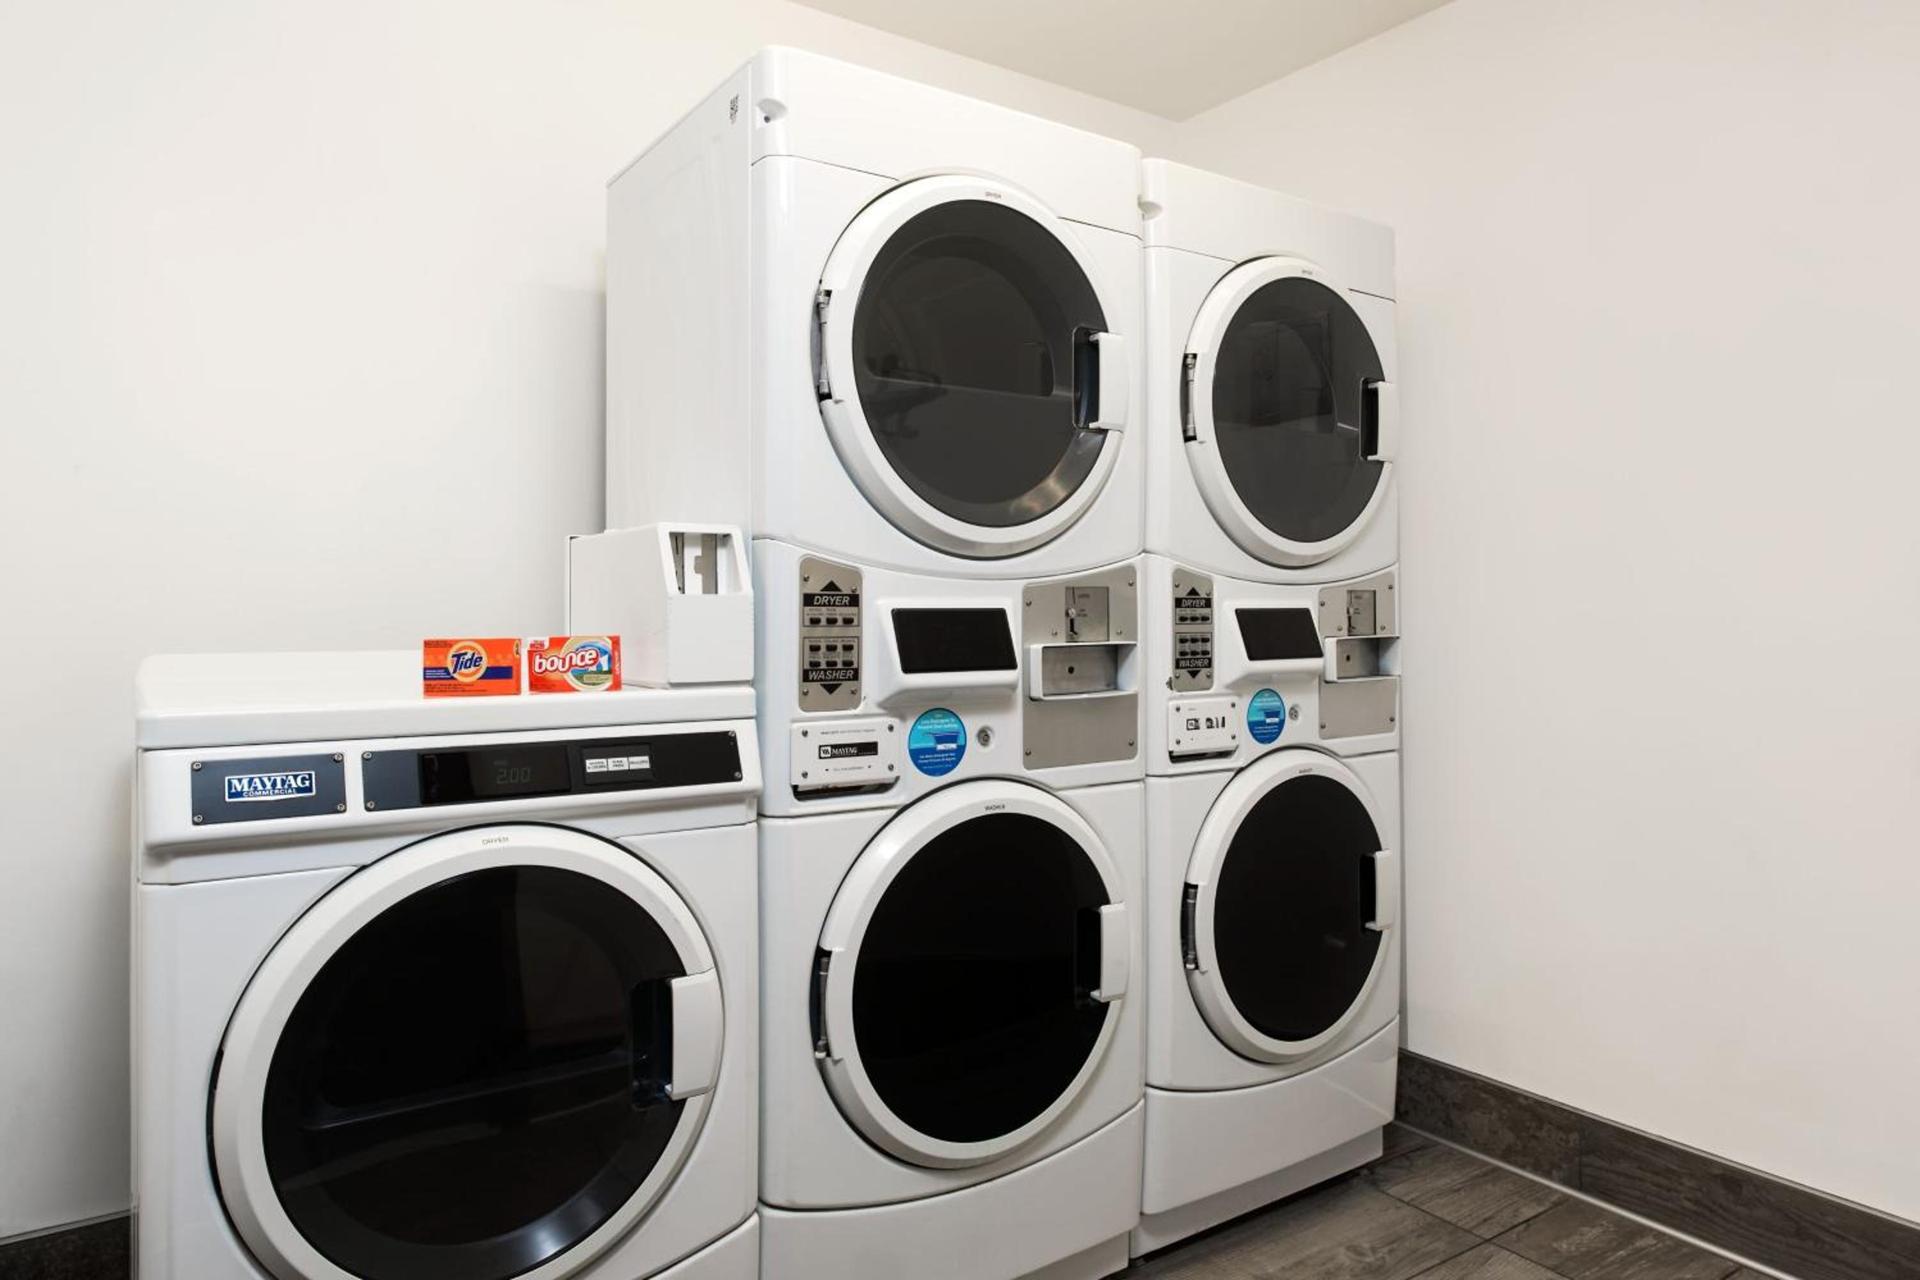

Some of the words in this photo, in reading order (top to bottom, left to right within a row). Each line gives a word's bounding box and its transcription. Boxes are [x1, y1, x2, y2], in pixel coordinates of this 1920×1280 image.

[814, 595, 850, 606] DRYER
[1182, 598, 1206, 608] DRYER
[451, 651, 483, 674] Tide
[534, 649, 597, 673] bounce
[1179, 658, 1209, 668] WASHER
[808, 669, 854, 680] WASHER
[831, 747, 858, 756] MAYTAG
[230, 774, 311, 793] MAYTAG
[243, 788, 297, 797] COMMERCIAL
